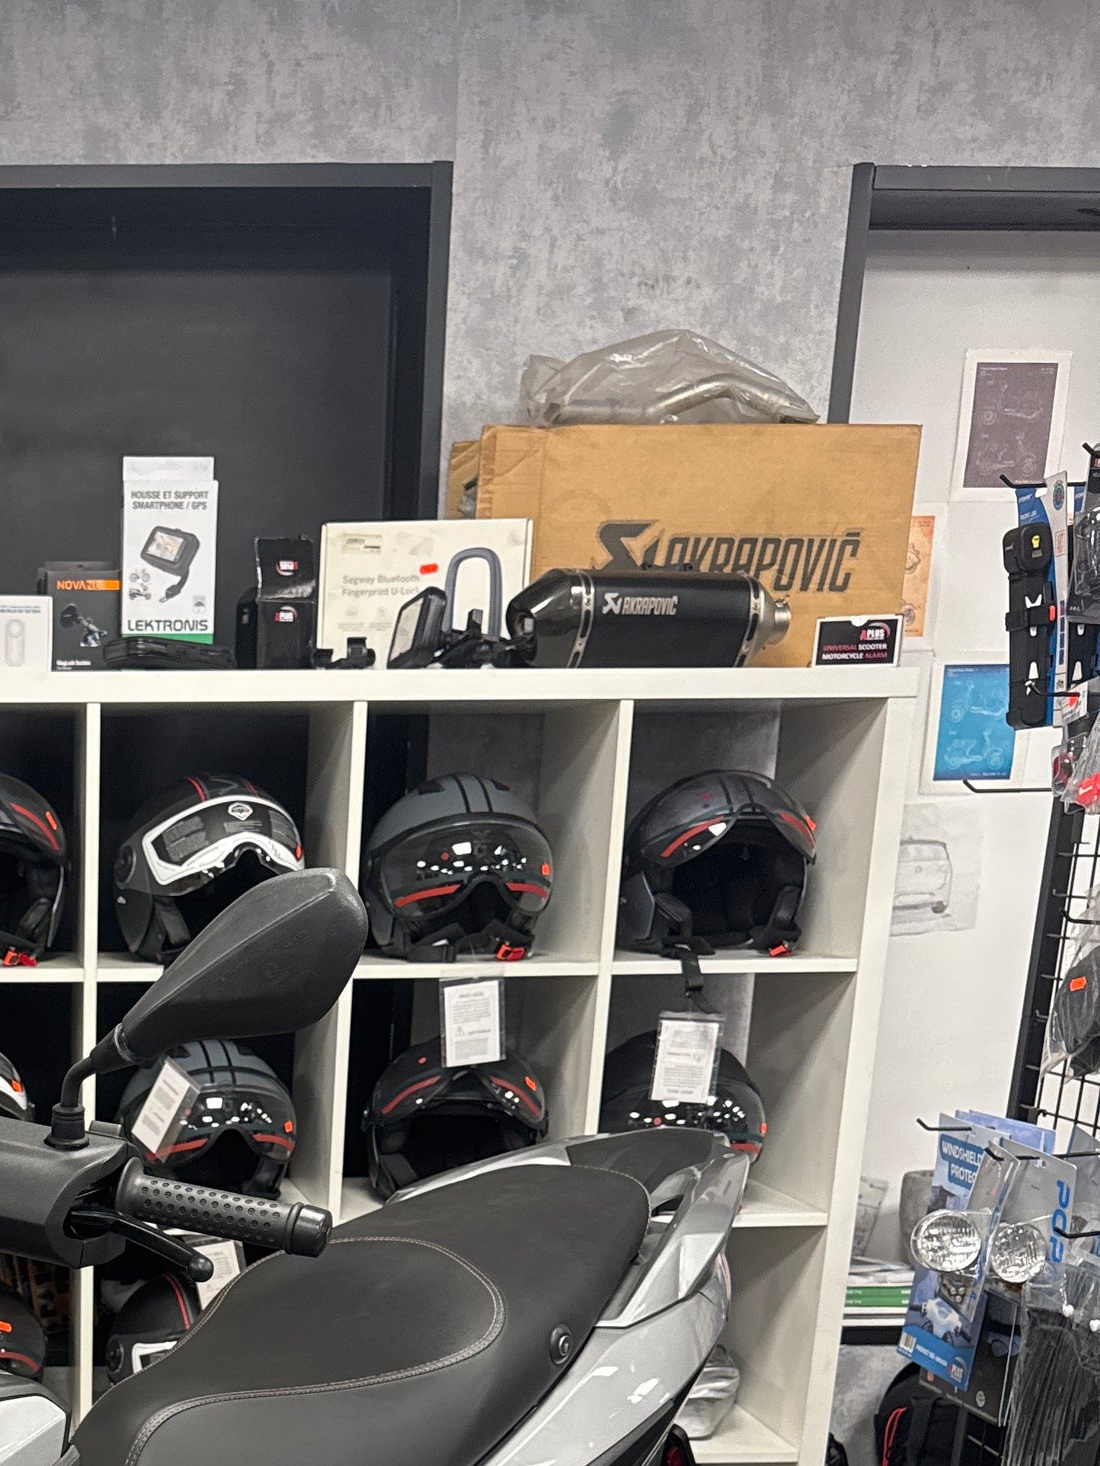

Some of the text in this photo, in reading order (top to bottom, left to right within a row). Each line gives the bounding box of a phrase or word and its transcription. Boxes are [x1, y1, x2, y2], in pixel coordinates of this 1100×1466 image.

[130, 490, 209, 500] HOUSSE ET SUPPORT
[132, 501, 184, 511] SMARTPHONE
[191, 501, 208, 511] GPS
[342, 573, 421, 586] Segway Bluetooth
[341, 587, 389, 598] Fingerprint
[127, 619, 209, 632] LEKTRONIS
[822, 642, 888, 652] UNIVERSAL SCOOTER
[821, 651, 888, 660] MOTORCYCLE ALARM
